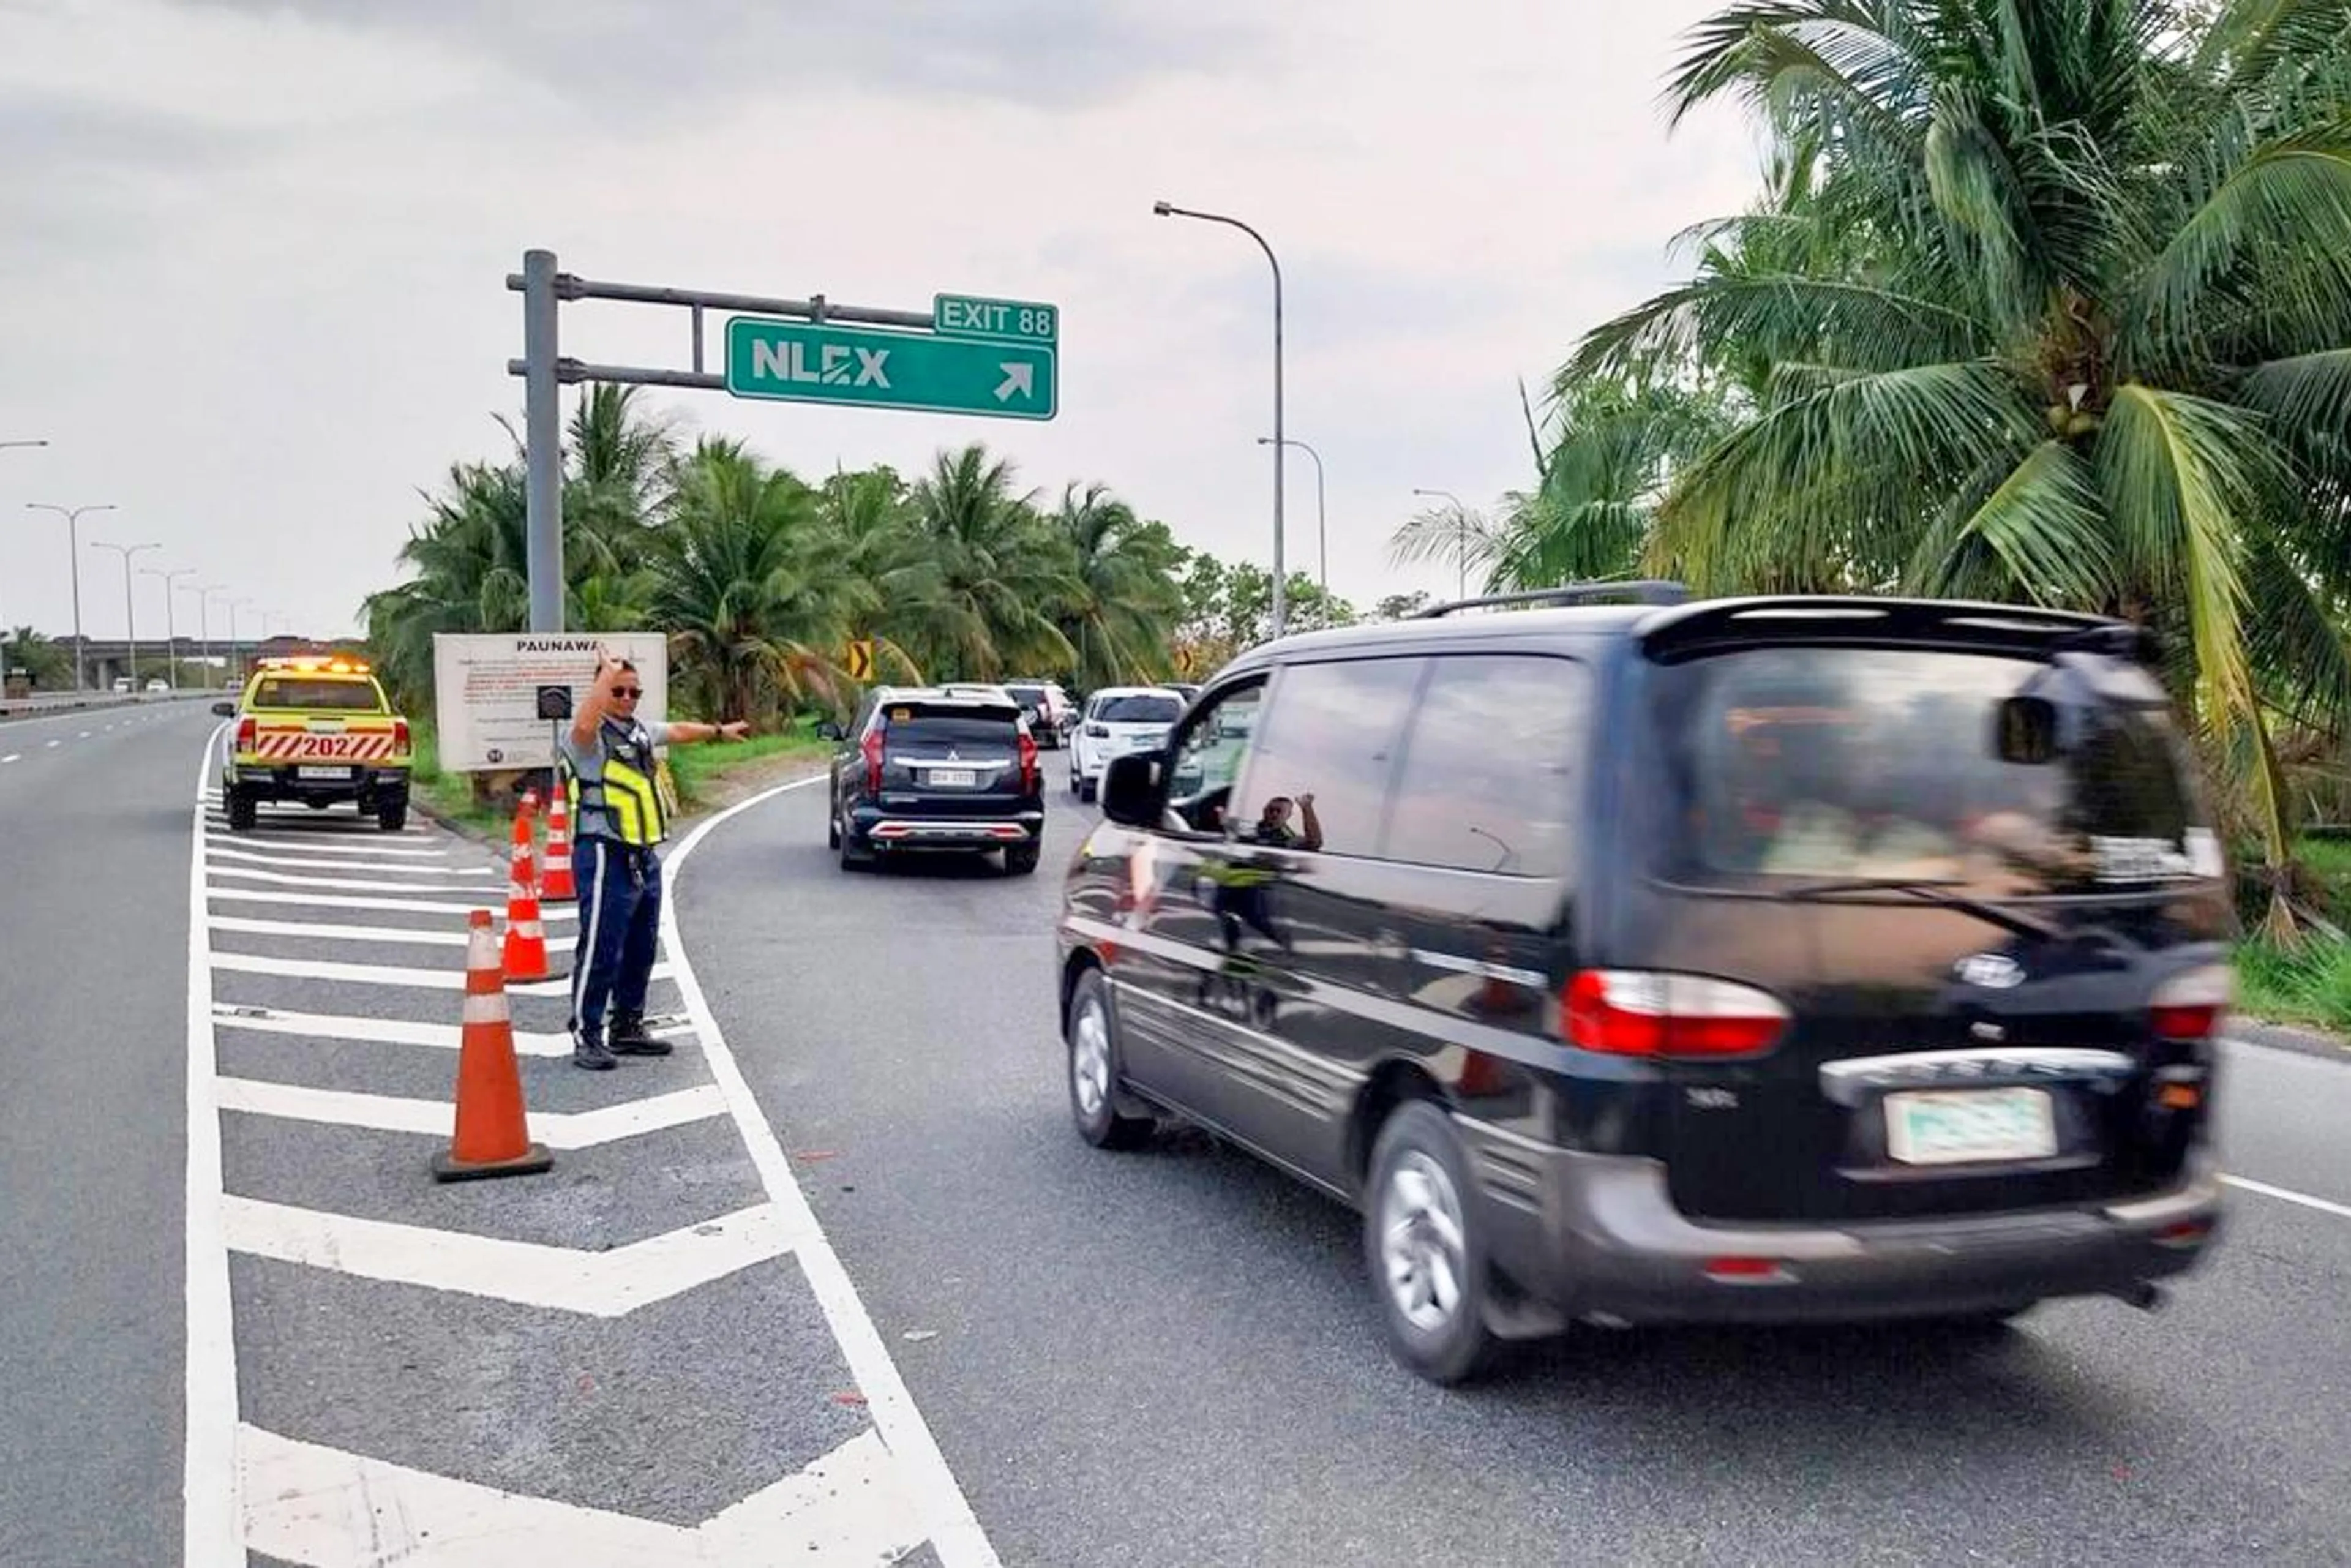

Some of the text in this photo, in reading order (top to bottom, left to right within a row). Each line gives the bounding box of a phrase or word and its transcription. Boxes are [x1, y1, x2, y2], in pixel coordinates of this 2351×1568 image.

[943, 301, 1051, 336] EXIT 88
[752, 338, 891, 389] NLEX
[304, 737, 348, 756] 202
